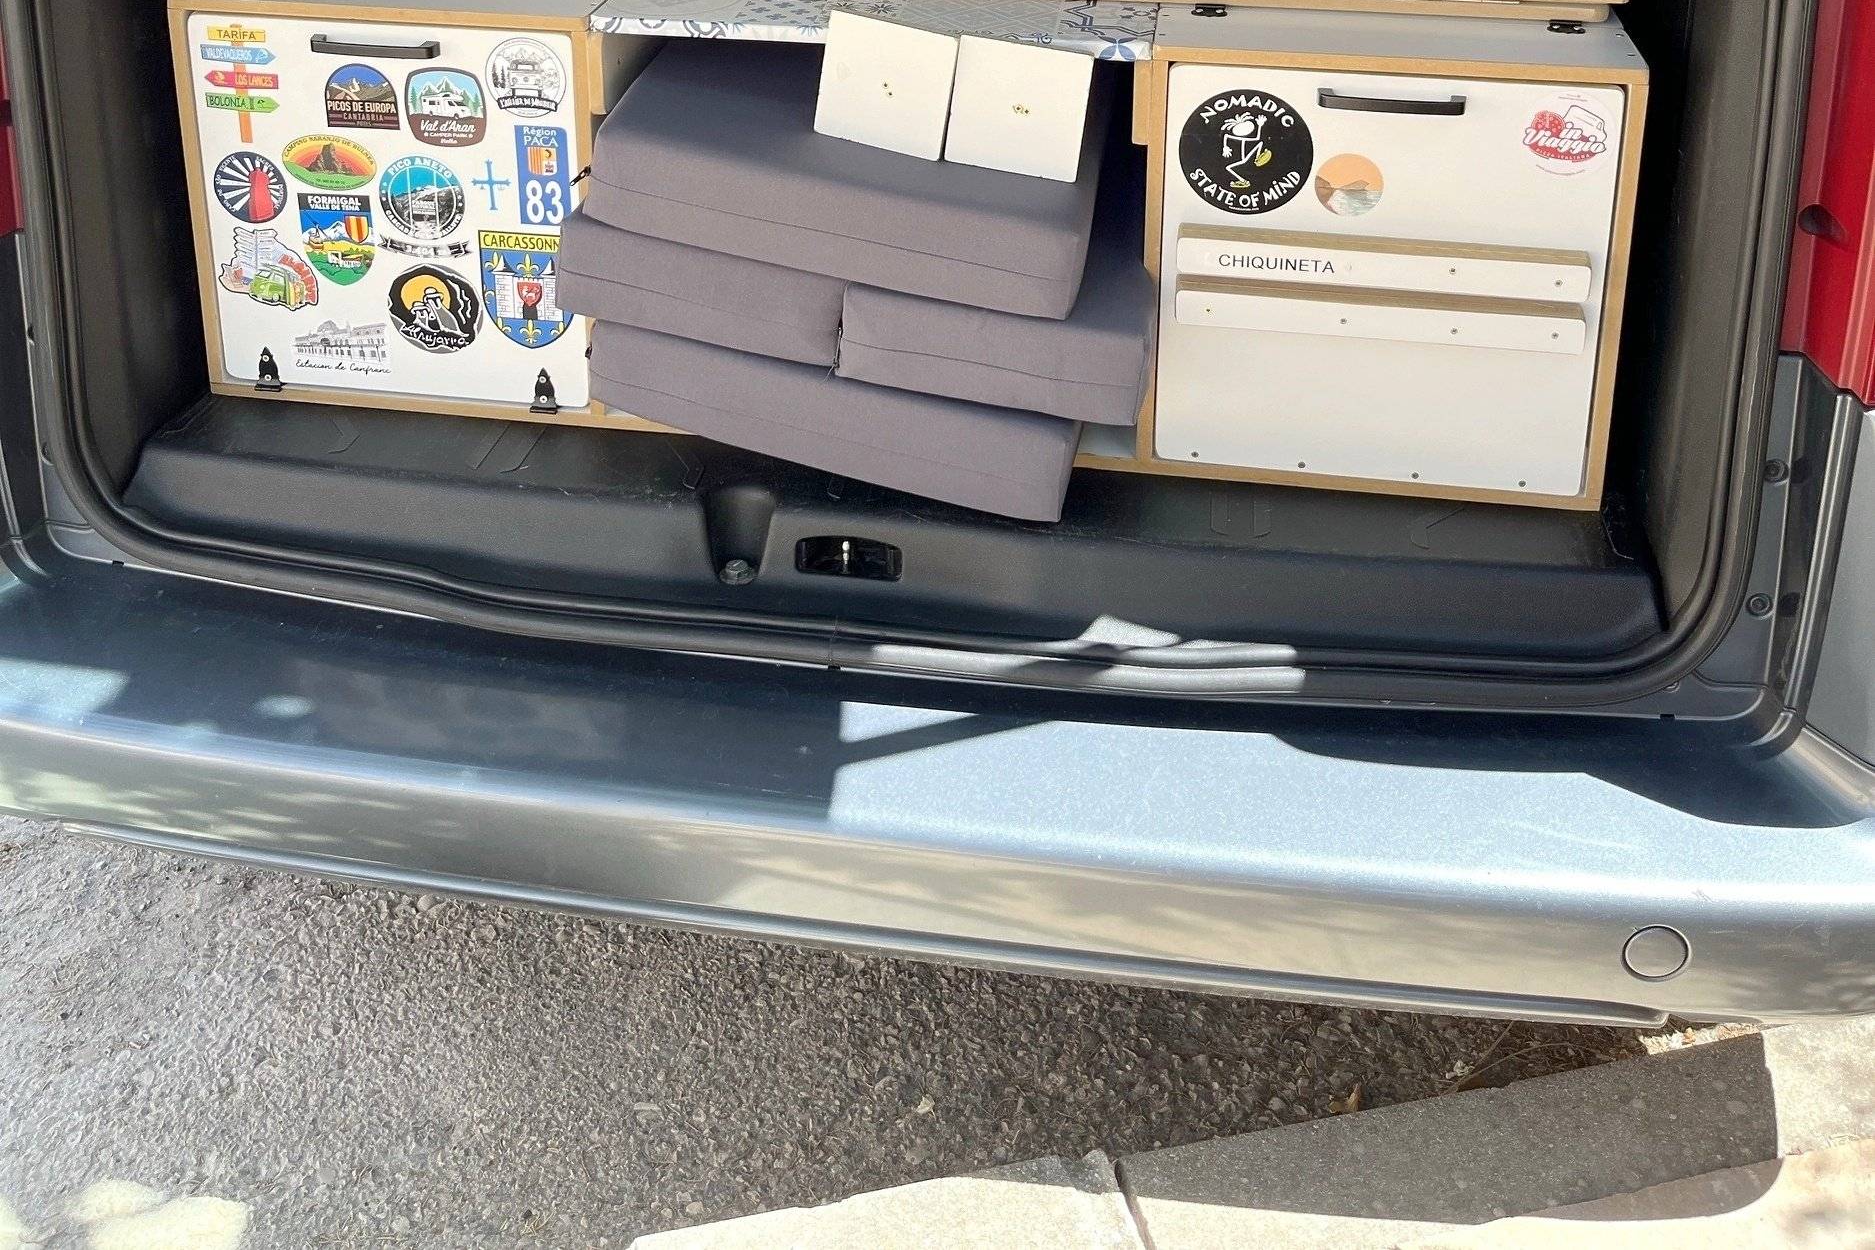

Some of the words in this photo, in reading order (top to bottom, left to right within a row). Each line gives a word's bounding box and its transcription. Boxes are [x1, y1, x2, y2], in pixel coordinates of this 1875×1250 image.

[235, 73, 248, 85] LOS
[327, 101, 351, 111] PICOS
[352, 102, 364, 112] DE
[365, 102, 396, 113] EUROPA
[1200, 94, 1295, 127] NOMADIC
[343, 113, 384, 121] CANTABRIA
[420, 119, 439, 131] Val
[440, 120, 477, 132] d'Aran
[523, 126, 557, 137] Région
[1559, 121, 1584, 141] in
[524, 136, 558, 147] PACA
[1523, 127, 1607, 155] Viaggio
[387, 158, 411, 176] PICO
[414, 157, 453, 178] ANETO
[1189, 168, 1236, 206] STATE
[1239, 191, 1260, 208] OF
[308, 195, 361, 205] FORMIGAL
[526, 179, 564, 224] 83
[483, 234, 560, 250] CARCASSONN
[1218, 254, 1335, 274] CHIQUINETA
[334, 361, 346, 371] de
[349, 363, 392, 375] Canfranc
